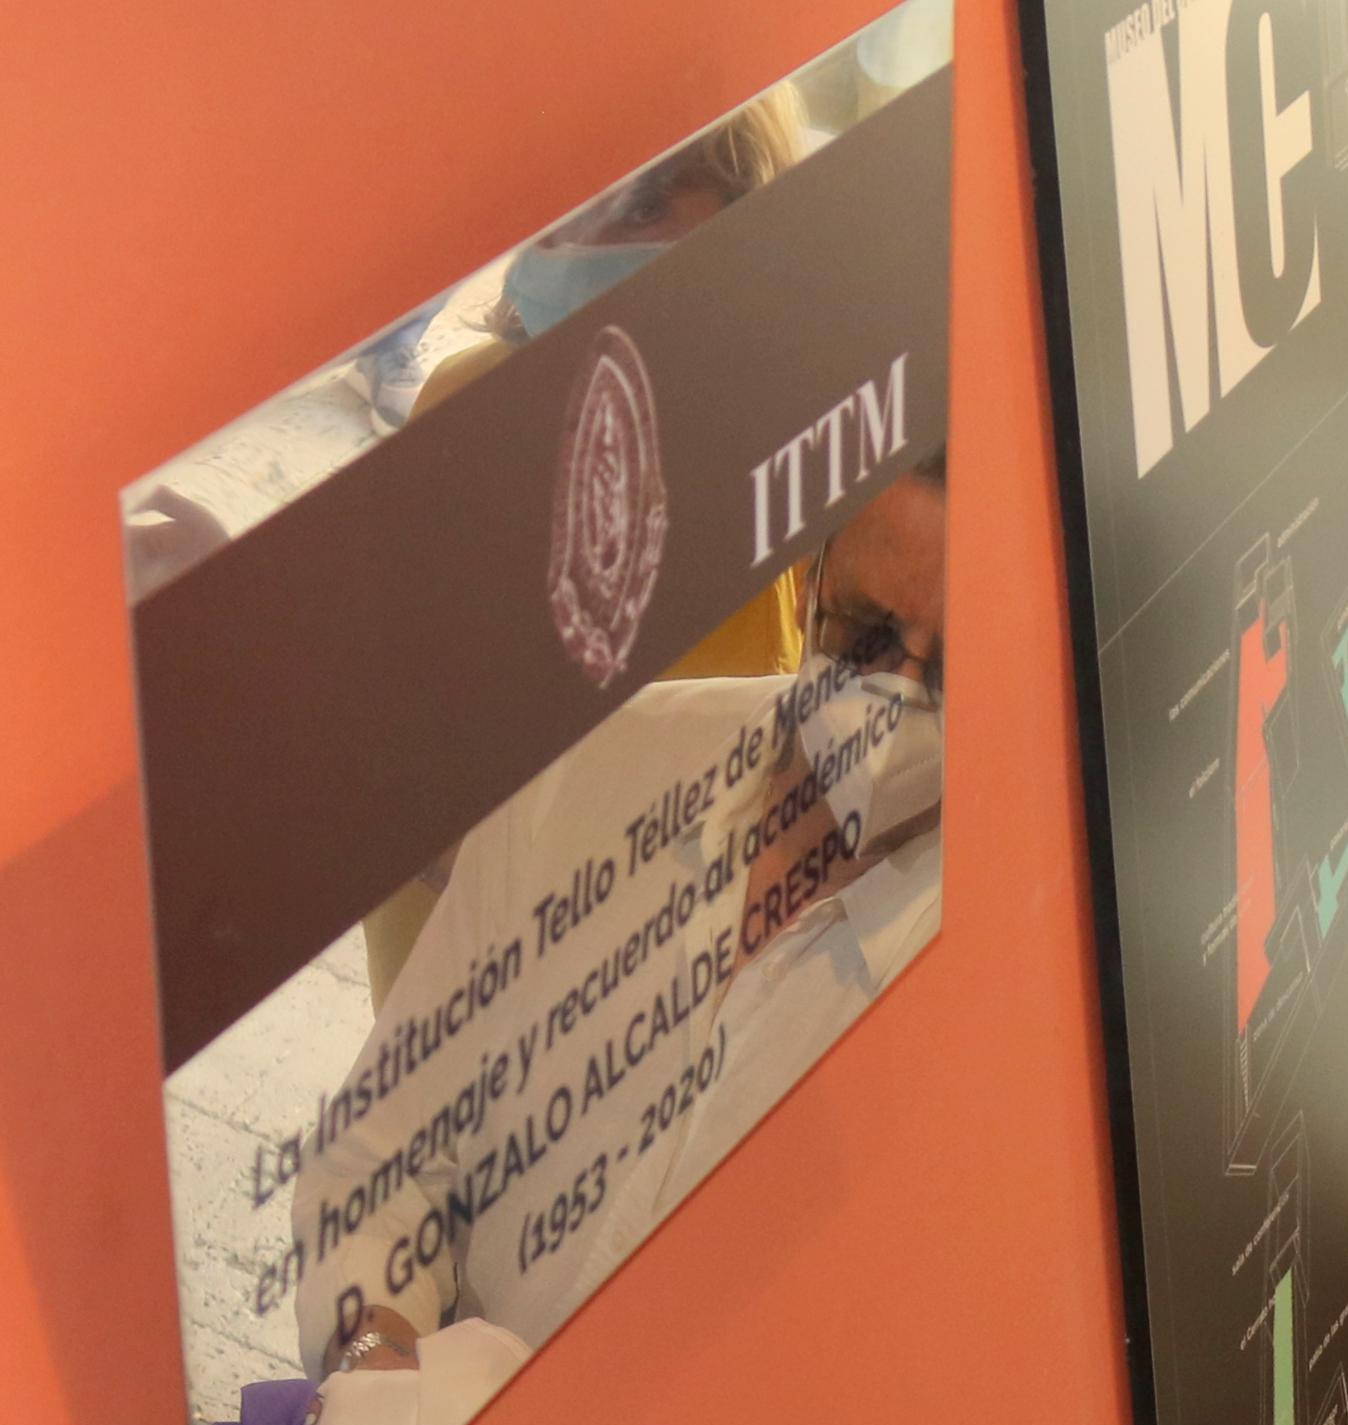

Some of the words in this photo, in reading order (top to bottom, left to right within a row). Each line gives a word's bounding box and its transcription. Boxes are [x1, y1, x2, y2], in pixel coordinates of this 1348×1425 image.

[750, 353, 910, 568] ITTM
[252, 1127, 302, 1210] La
[316, 943, 522, 1156] Institución
[533, 856, 616, 958] Tello
[625, 764, 720, 877] Téllez
[725, 725, 765, 789] de
[255, 1237, 308, 1317] en
[317, 1048, 511, 1264] homenaje
[516, 1021, 541, 1096] y
[546, 878, 698, 1052] recuerdo
[703, 831, 736, 903] al
[741, 692, 904, 868] académico
[336, 1283, 376, 1347] D.
[385, 1086, 574, 1297] GONZALO
[580, 927, 736, 1117] ALCALDE
[739, 807, 864, 958] CRESPO
[518, 1152, 610, 1277] (1953
[638, 1020, 728, 1159] 2020)
